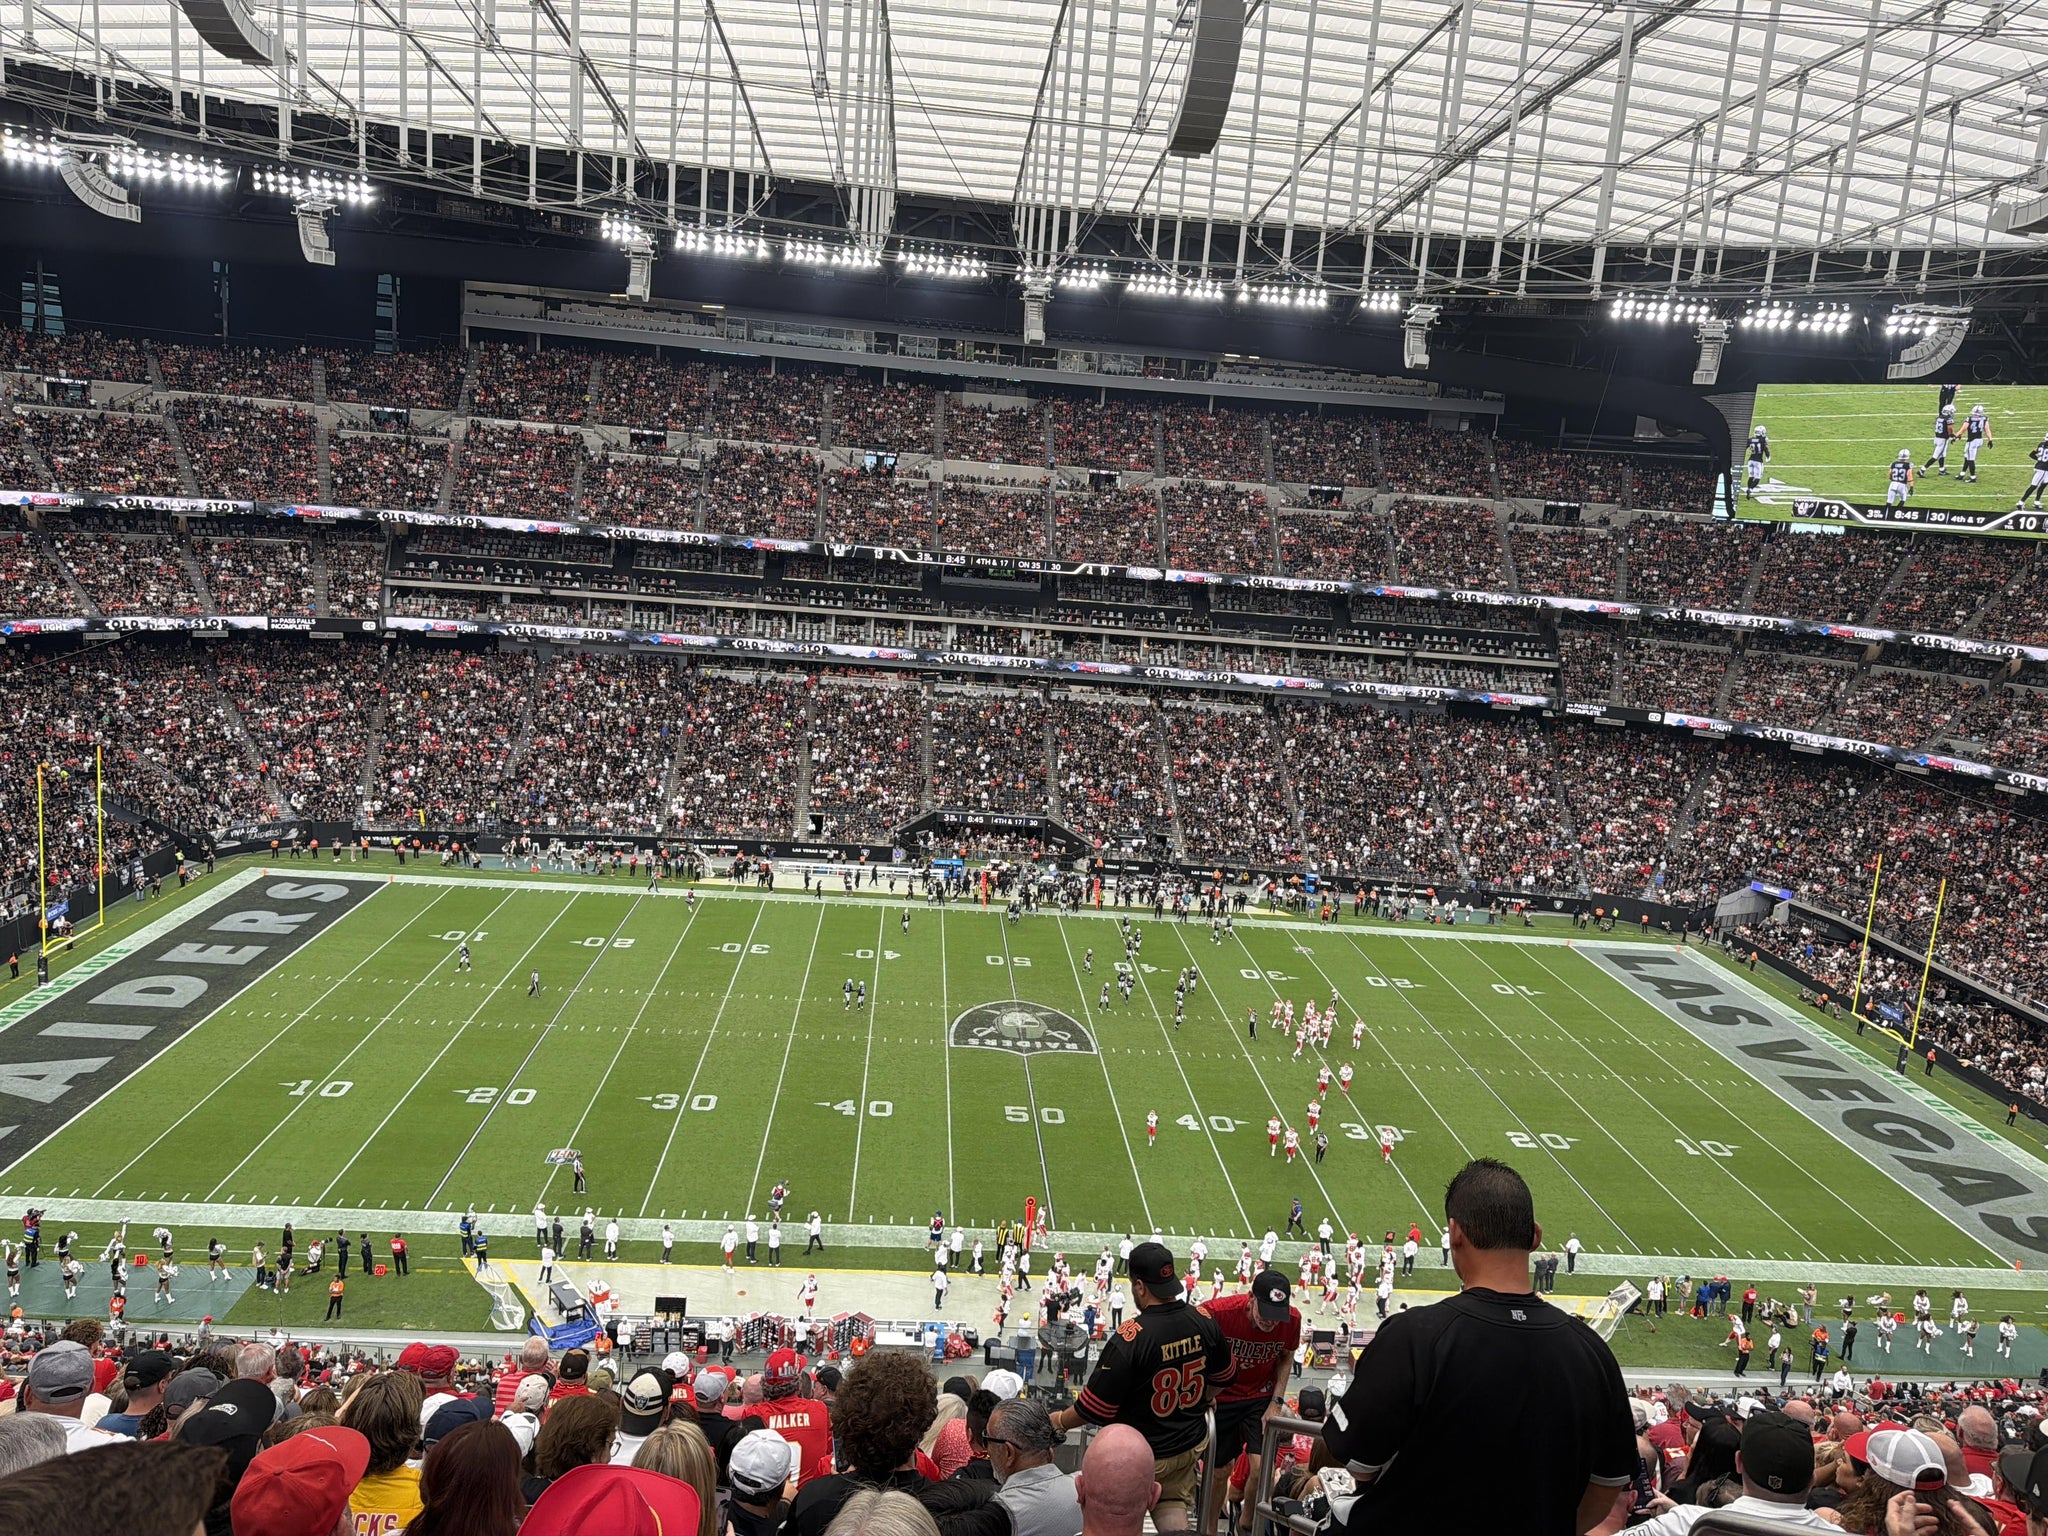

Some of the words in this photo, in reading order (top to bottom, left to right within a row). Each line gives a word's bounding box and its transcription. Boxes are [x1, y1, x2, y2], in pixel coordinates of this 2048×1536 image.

[1892, 468, 1906, 481] 23
[60, 498, 84, 506] LIGHT
[322, 510, 344, 518] LIGHT
[1824, 504, 1840, 518] 13
[1895, 510, 1919, 520] 8:45
[1930, 512, 1945, 522] 30
[2019, 516, 2036, 530] 10
[560, 526, 580, 534] LIGHT
[775, 544, 796, 552] LIGHT
[946, 554, 966, 564] 8:45
[976, 558, 990, 566] 4TH
[992, 559, 998, 567] &
[1000, 560, 1008, 568] 17
[1018, 561, 1030, 570] ON
[1032, 562, 1040, 570] 35
[1051, 564, 1061, 572] 30
[1100, 566, 1109, 576] 10
[1404, 590, 1424, 598] LIGHT
[1620, 606, 1640, 615] LIGHT
[41, 624, 67, 632] LIGHT
[457, 625, 478, 634] LIGHT
[1854, 631, 1876, 640] LIGHT
[683, 637, 704, 646] LIGHT
[898, 652, 917, 660] LIGHT
[1512, 698, 1532, 706] LIGHT
[1710, 722, 1733, 732] LIGHT
[1954, 764, 1978, 774] LIGHT
[442, 930, 488, 942] 10
[582, 936, 636, 948] 20
[722, 942, 770, 954] 30
[856, 949, 901, 960] 40
[70, 948, 133, 975] LOVE
[986, 956, 1032, 966] 50
[1114, 962, 1158, 973] 40
[1240, 969, 1288, 980] 30
[1366, 976, 1414, 988] 20
[1492, 984, 1534, 996] 10
[0, 881, 349, 1140] AIDERS
[968, 1038, 1078, 1050] RAIDERS
[288, 1080, 354, 1098] 10
[464, 1086, 538, 1105] 20
[652, 1093, 718, 1111] 30
[1604, 954, 1773, 1028] LAS
[1736, 1038, 2048, 1255] VEGAS
[832, 1100, 894, 1117] 40
[1004, 1106, 1066, 1124] 50
[1924, 1099, 1963, 1116] OF
[1959, 1122, 2002, 1142] US
[1176, 1114, 1235, 1132] 40
[1340, 1122, 1404, 1141] 30
[1505, 1132, 1570, 1149] 20
[1674, 1138, 1733, 1156] 10
[136, 1256, 144, 1264] 10
[376, 1266, 384, 1274] 20
[1511, 1310, 1527, 1321] NFL
[1117, 1318, 1143, 1342] 85
[1161, 1334, 1202, 1362] KITTLE
[1225, 1337, 1284, 1360] HIEFS
[1151, 1354, 1207, 1418] 85
[769, 1412, 810, 1429] WALKER
